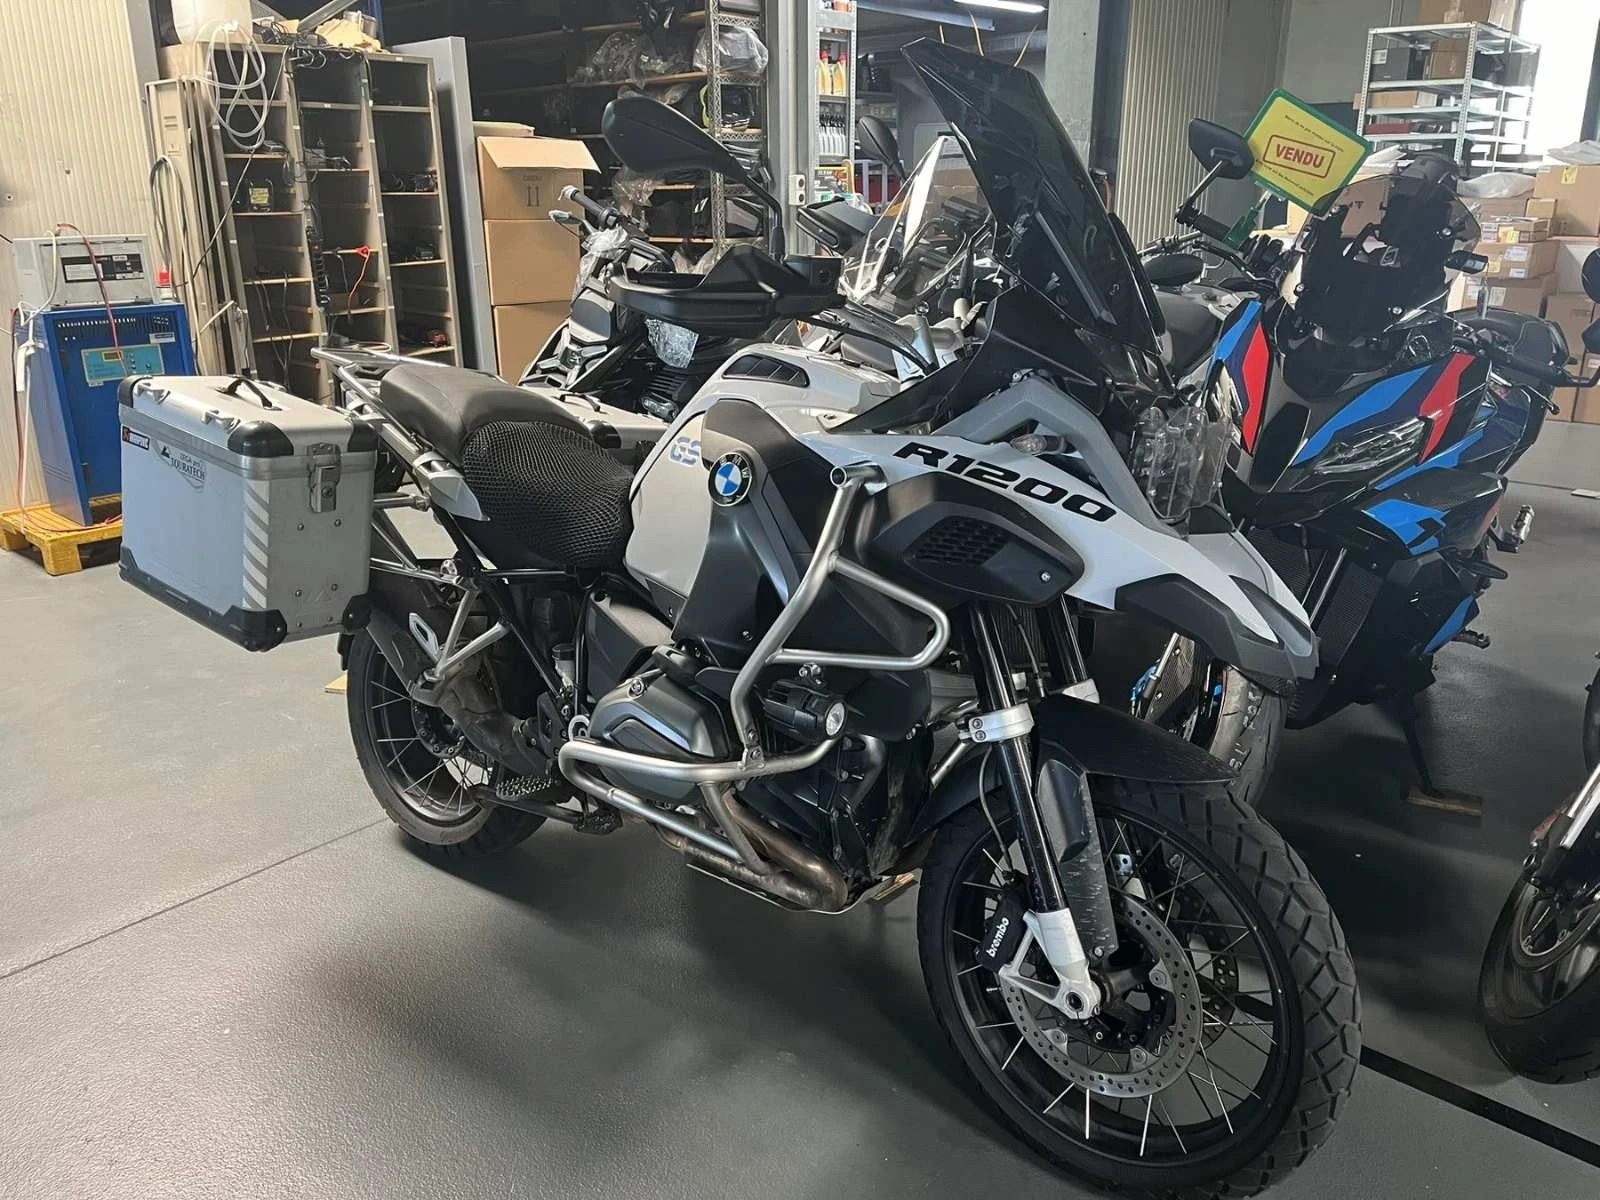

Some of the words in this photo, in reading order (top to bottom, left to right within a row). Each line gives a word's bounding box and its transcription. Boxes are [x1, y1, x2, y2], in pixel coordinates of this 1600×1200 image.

[1274, 143, 1325, 169] VENDU
[669, 436, 702, 466] GS
[719, 455, 750, 479] BMW
[892, 441, 1117, 522] R1200
[986, 917, 1010, 958] brembo
